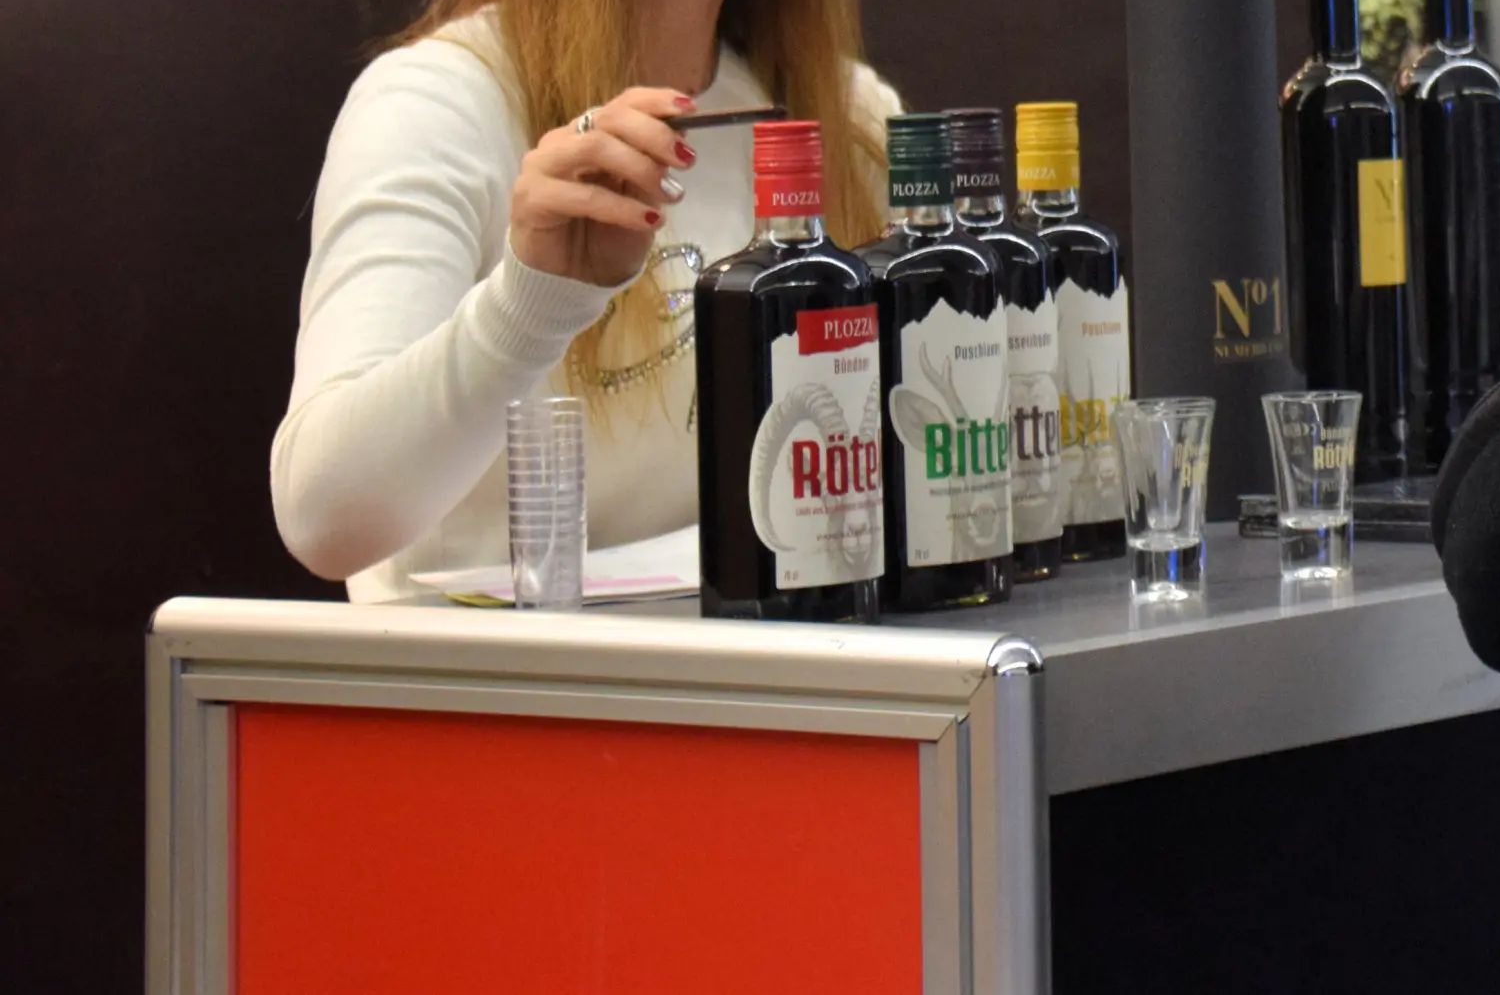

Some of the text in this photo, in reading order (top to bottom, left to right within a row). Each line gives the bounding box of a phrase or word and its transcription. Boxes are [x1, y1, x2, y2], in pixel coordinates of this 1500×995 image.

[956, 173, 1000, 188] PLOZZA
[892, 182, 940, 197] PLOZZA
[772, 191, 821, 206] PLOZZA
[823, 317, 875, 340] PLOZZA
